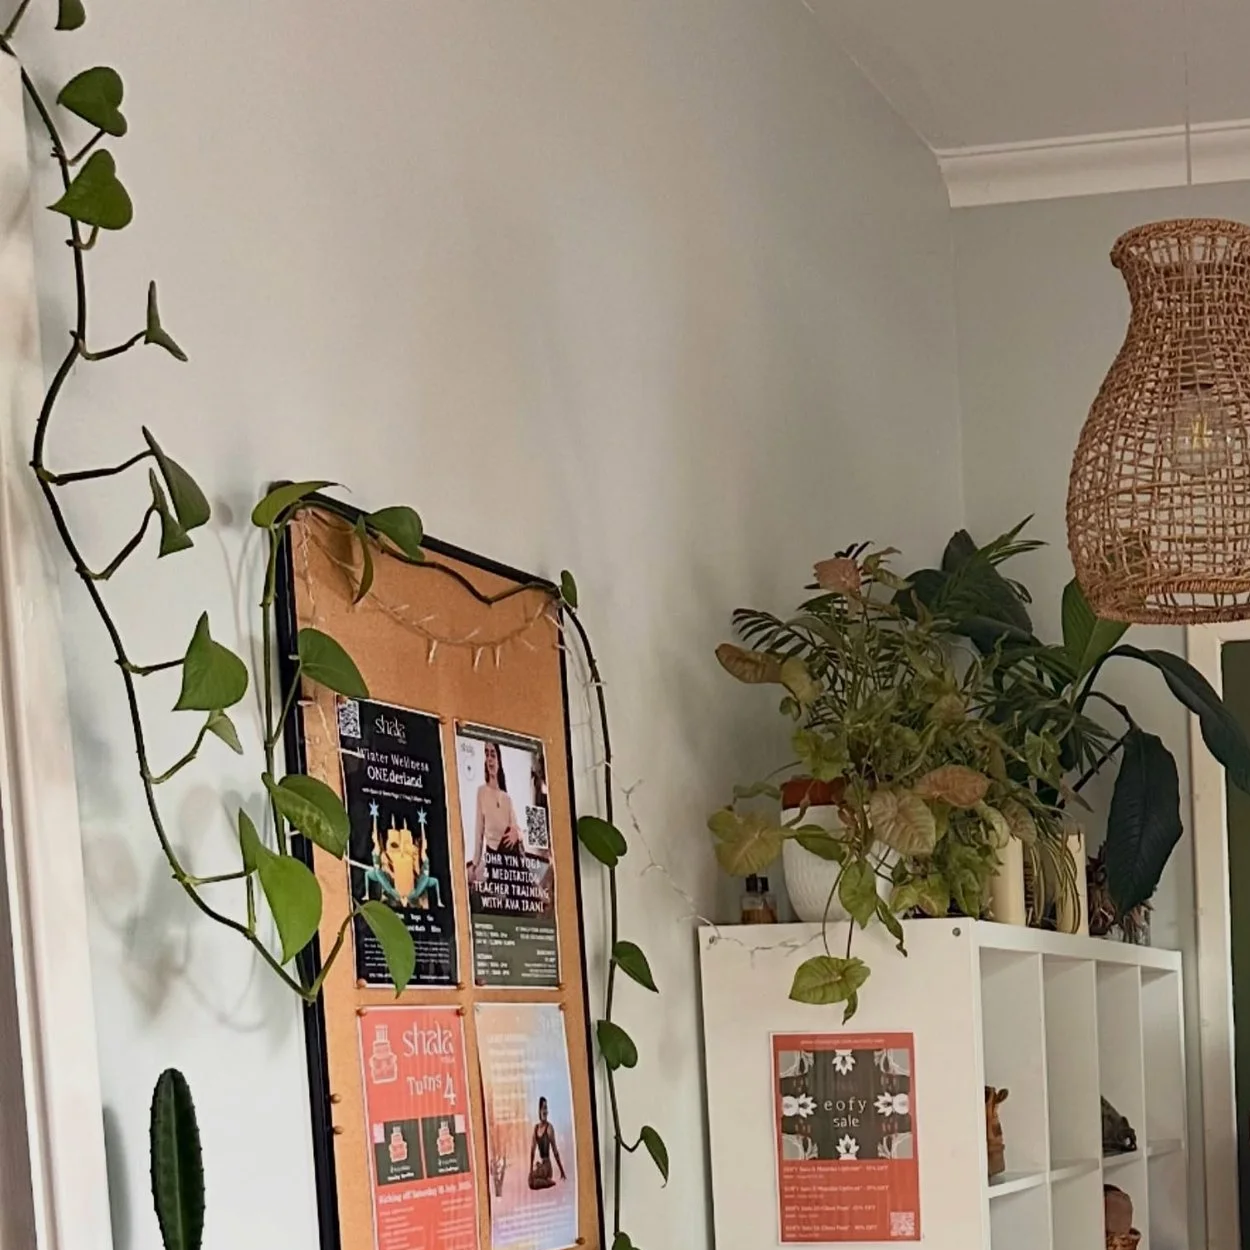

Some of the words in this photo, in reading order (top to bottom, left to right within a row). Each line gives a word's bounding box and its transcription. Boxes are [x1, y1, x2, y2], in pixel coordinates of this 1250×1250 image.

[391, 753, 430, 772] Wellness
[474, 881, 509, 895] TEACHER
[481, 896, 504, 909] WITH
[402, 1020, 454, 1057] shala
[406, 1073, 441, 1096] Turns
[443, 1071, 457, 1106] 4
[833, 1114, 860, 1128] sale
